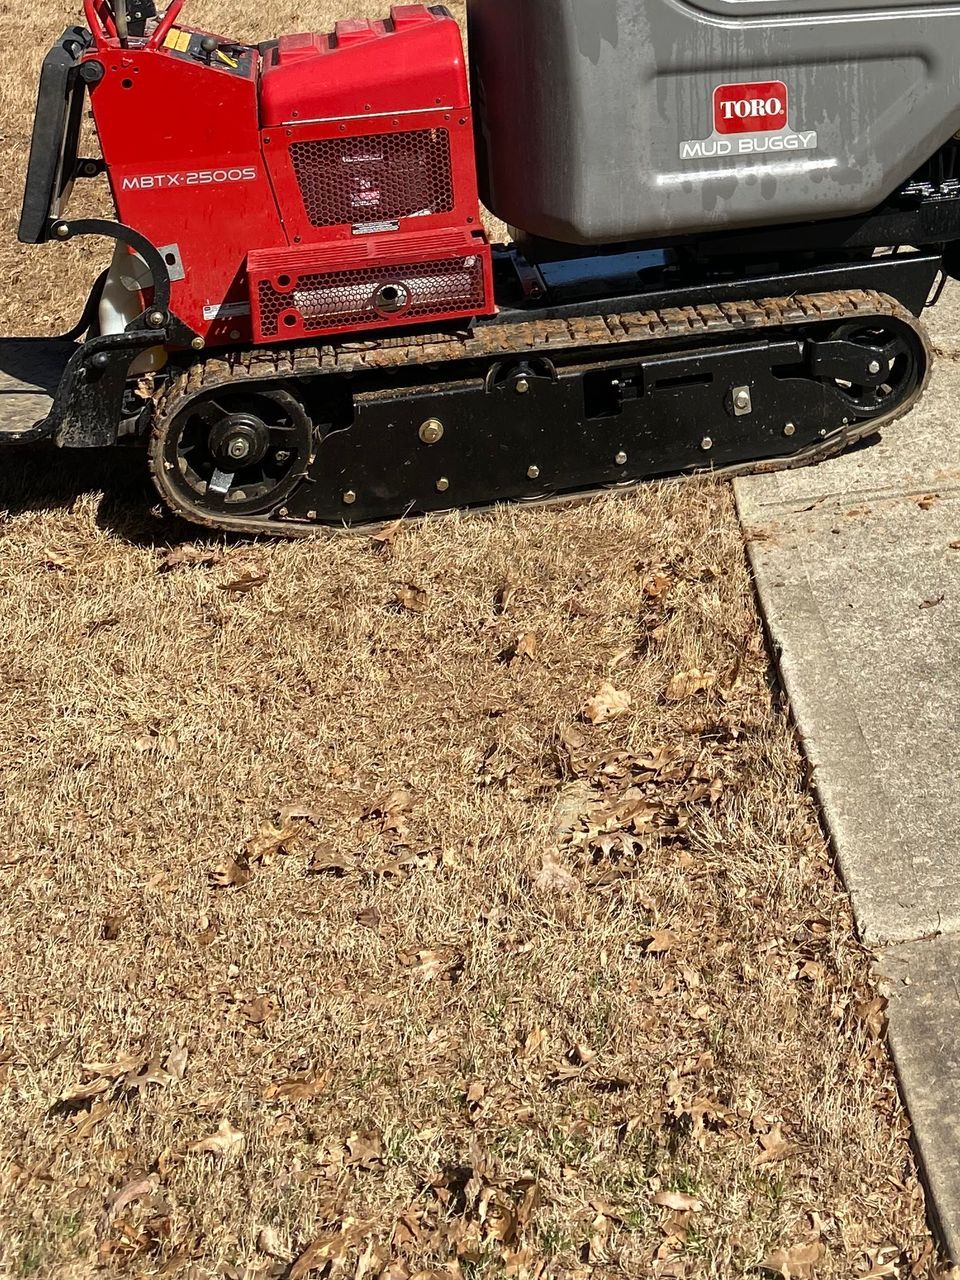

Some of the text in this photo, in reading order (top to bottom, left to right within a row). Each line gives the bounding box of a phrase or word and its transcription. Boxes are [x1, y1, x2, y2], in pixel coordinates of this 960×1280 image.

[720, 97, 784, 119] TORO
[682, 131, 812, 158] MUD BUGGY
